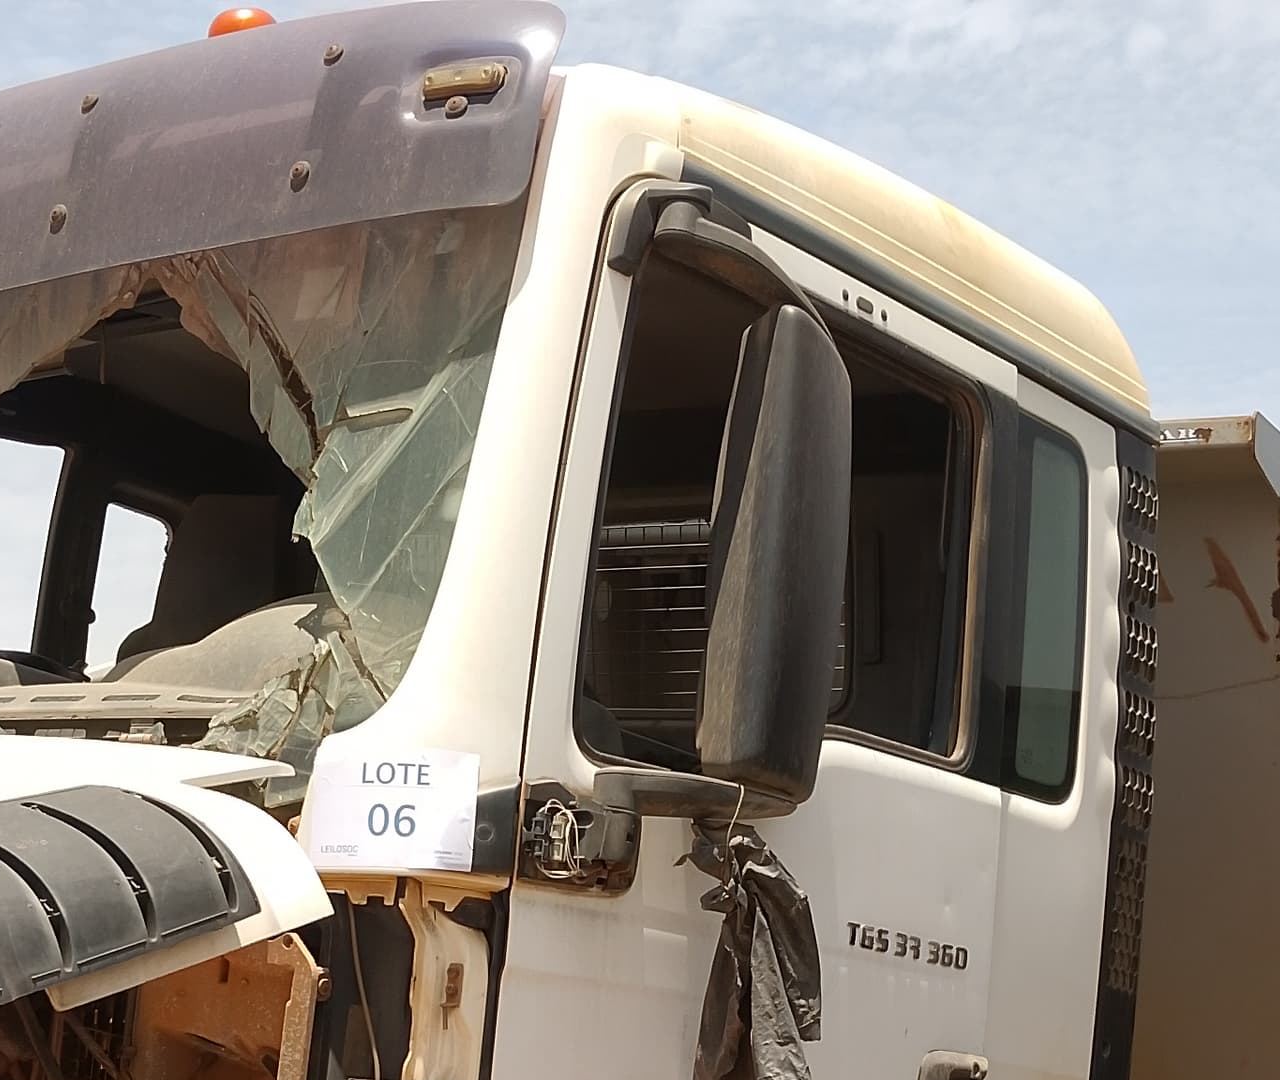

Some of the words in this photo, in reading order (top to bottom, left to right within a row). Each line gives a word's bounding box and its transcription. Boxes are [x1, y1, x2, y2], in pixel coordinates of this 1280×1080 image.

[361, 762, 431, 786] LOTE
[367, 803, 417, 837] 06
[846, 921, 889, 953] TGS
[926, 940, 969, 970] 360
